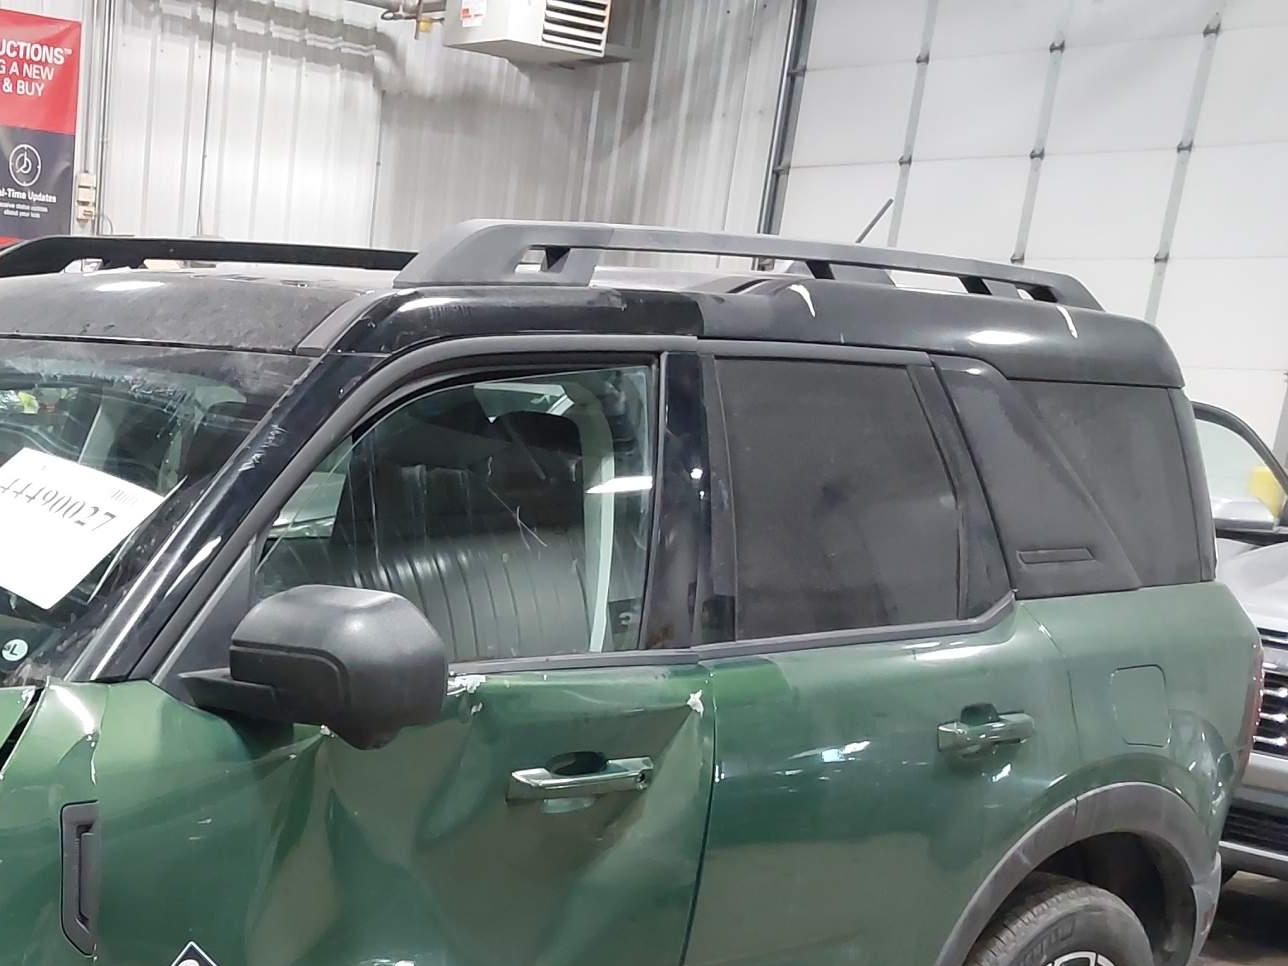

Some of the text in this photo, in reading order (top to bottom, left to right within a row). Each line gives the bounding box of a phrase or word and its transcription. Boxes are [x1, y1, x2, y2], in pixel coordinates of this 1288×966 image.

[9, 62, 20, 76] A
[23, 64, 55, 81] NEW
[2, 78, 13, 93] &
[16, 80, 45, 97] BUY
[27, 190, 57, 203] Updates
[0, 477, 117, 532] 44490027
